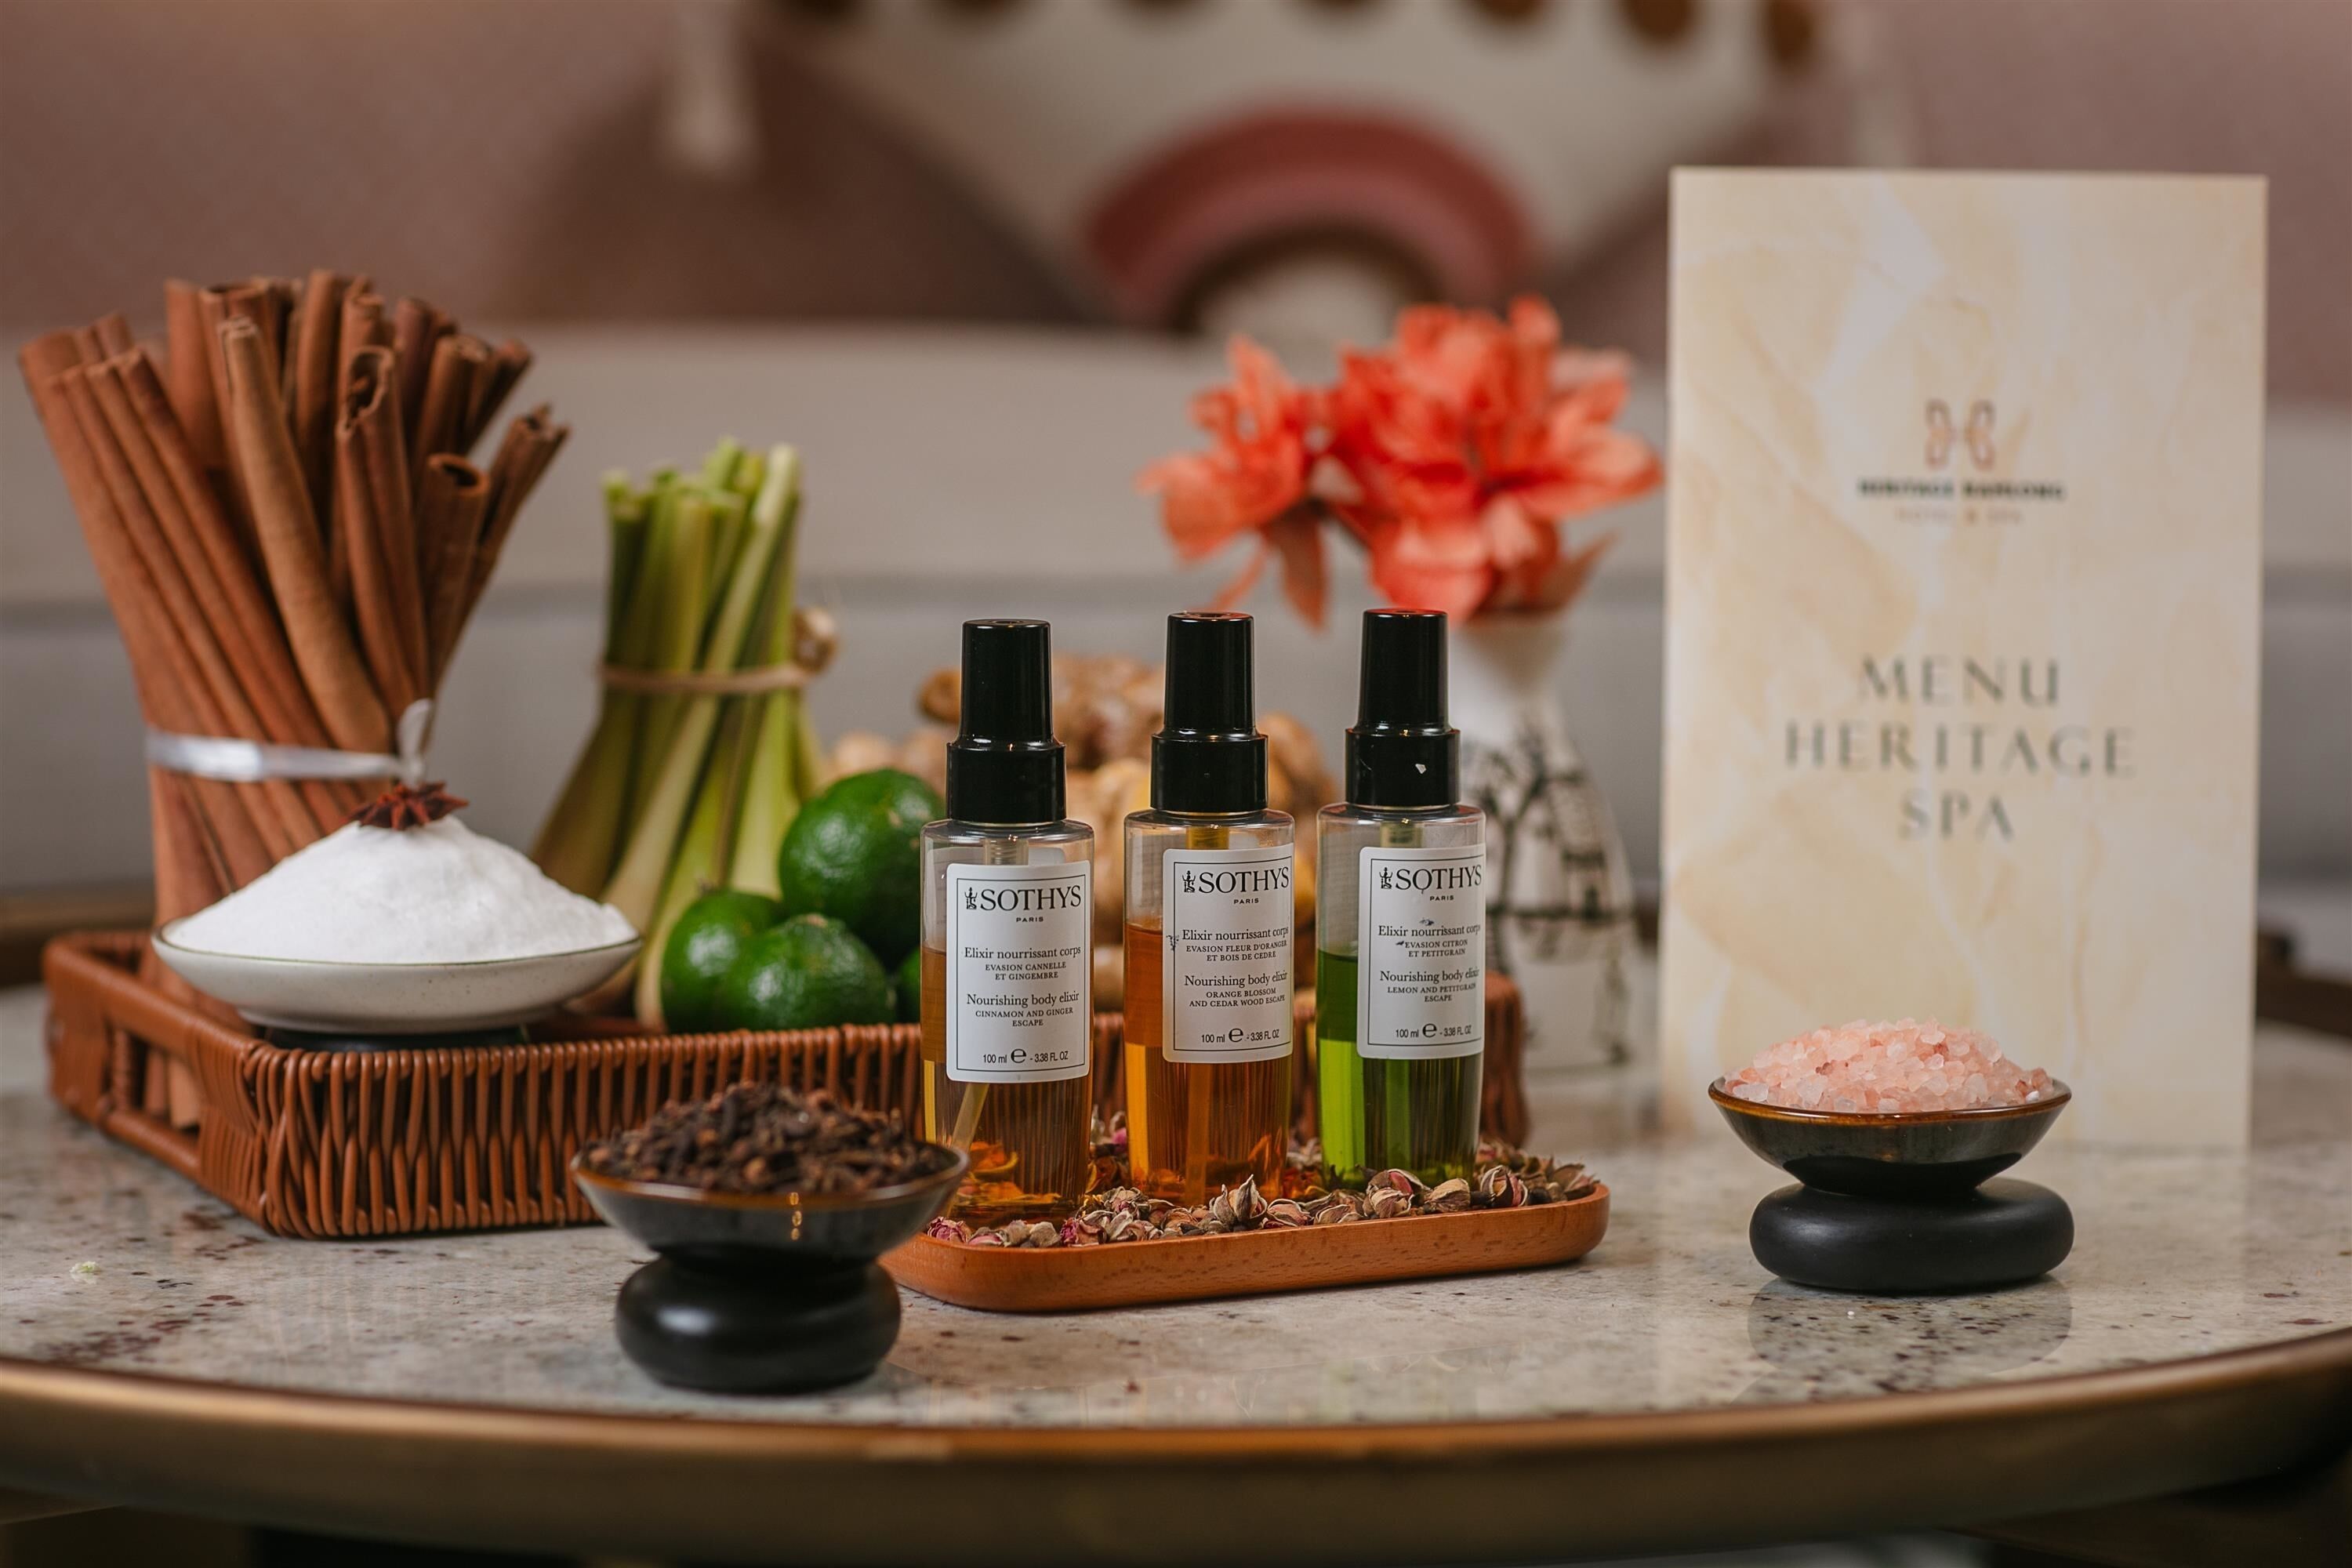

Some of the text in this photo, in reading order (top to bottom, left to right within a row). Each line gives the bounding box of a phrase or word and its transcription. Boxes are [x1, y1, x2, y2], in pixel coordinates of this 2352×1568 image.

[1858, 655, 2060, 706] MENU
[1785, 718, 2138, 779] HERITAGE
[1898, 788, 2014, 841] SPA
[1199, 866, 1289, 894] SOTHYS
[1396, 864, 1482, 891] SOTHYS
[980, 885, 1081, 911] SOTHYS
[1182, 930, 1212, 941] Elixir
[1215, 929, 1271, 941] nourrissant
[1378, 925, 1408, 936] Elixir
[1411, 925, 1465, 937] nourrissant
[1254, 940, 1287, 951] D'ORANGER
[1442, 939, 1468, 948] CITRON
[964, 946, 1081, 959] Elixir nourrissant corps
[1254, 951, 1276, 960] CEDRE
[1421, 948, 1466, 957] PETITGRAIN
[1025, 962, 1066, 971] CANNELLE
[1008, 971, 1058, 980] GINGEMBRE
[1185, 970, 1287, 988] Nourishing body elixir
[1380, 971, 1439, 984] Nourishing
[1442, 969, 1465, 982] body
[1244, 988, 1276, 997] BLOSSOM
[1439, 982, 1476, 993] PETITGRAIN
[967, 991, 1080, 1007] Nourishing body elixir
[1265, 995, 1286, 1004] ESCAPE
[1046, 1007, 1073, 1016] GINGER
[1202, 1034, 1214, 1044] 100
[1216, 1034, 1225, 1043] ml
[1250, 1032, 1263, 1041] 3.38
[1272, 1029, 1279, 1039] OZ
[1396, 1029, 1409, 1038] 100
[1443, 1027, 1456, 1036] 3.38
[983, 1054, 996, 1063] 100
[998, 1054, 1007, 1063] ml
[1034, 1053, 1048, 1062] 3.38
[1059, 1051, 1069, 1060] OZ
